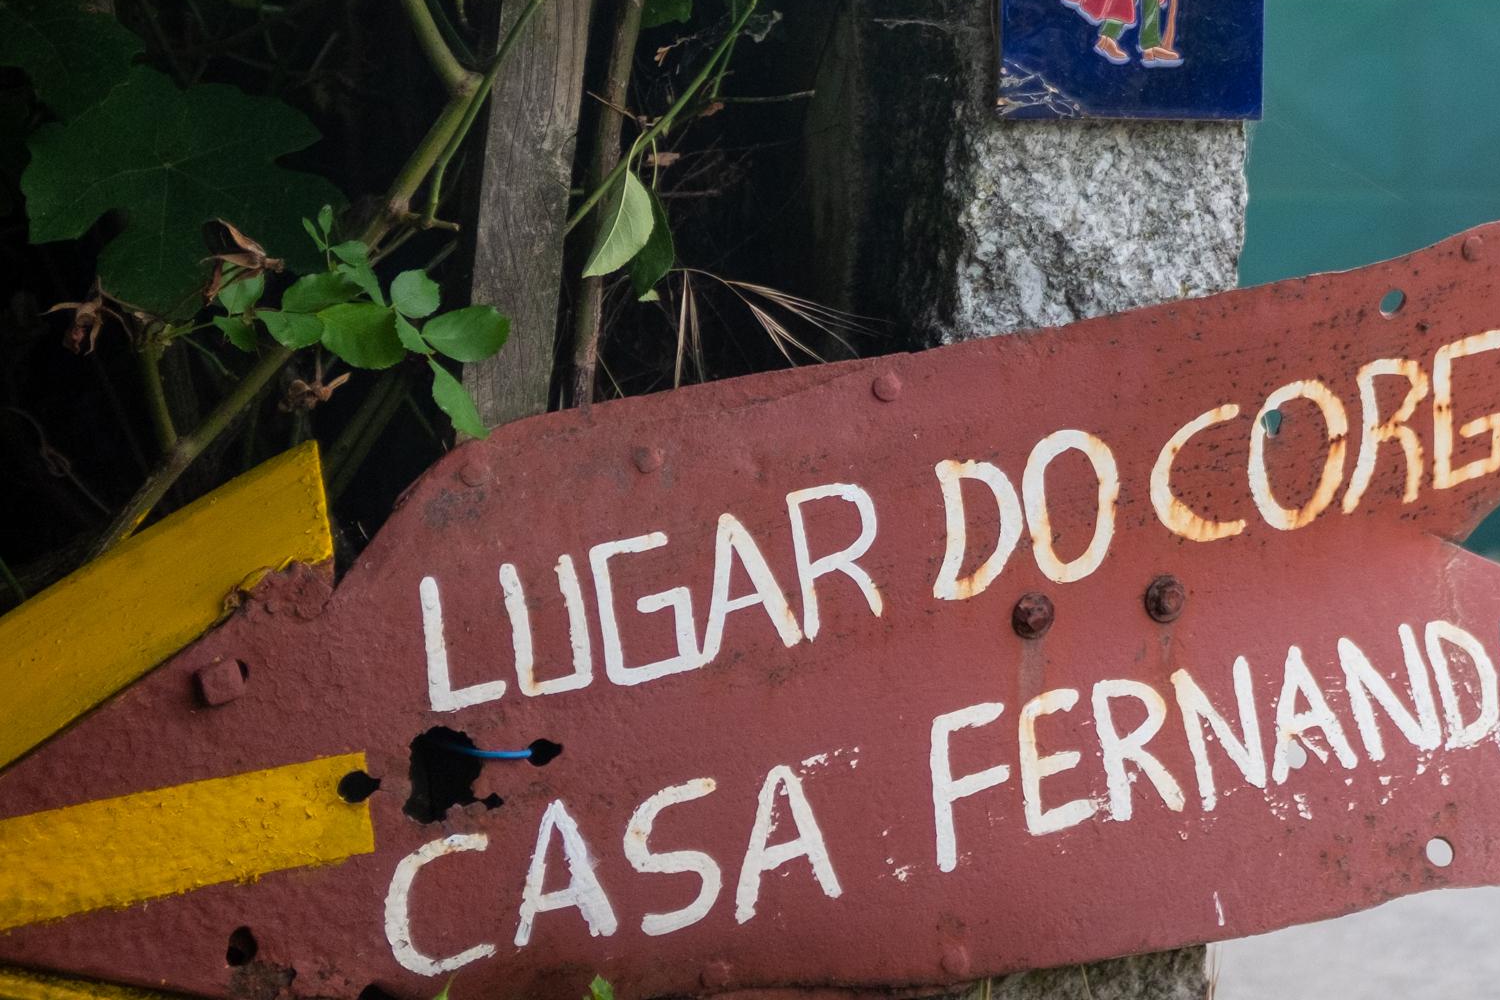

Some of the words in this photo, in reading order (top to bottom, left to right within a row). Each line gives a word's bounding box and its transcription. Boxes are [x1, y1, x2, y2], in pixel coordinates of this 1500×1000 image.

[420, 483, 882, 712] LUGAR
[932, 429, 1120, 600] DO
[384, 764, 843, 976] CASA
